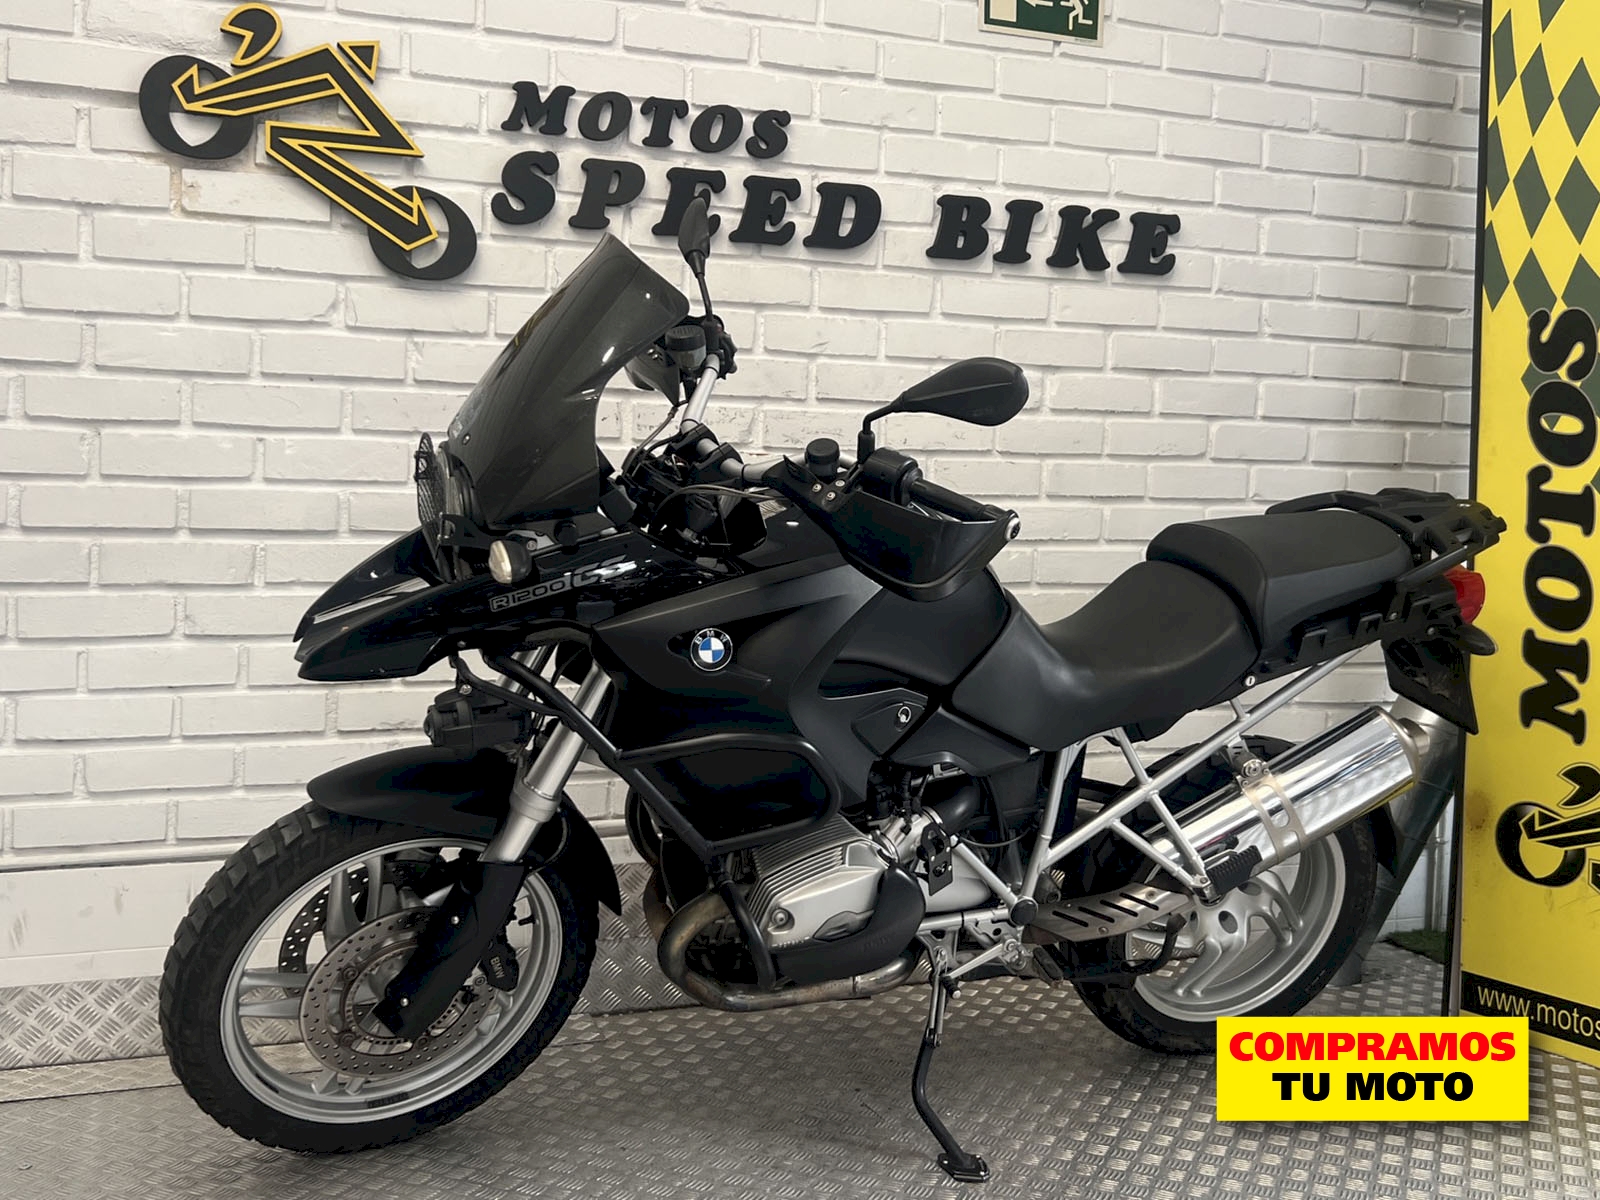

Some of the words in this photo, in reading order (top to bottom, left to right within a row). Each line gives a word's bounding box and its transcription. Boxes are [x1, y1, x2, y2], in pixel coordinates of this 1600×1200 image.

[501, 81, 791, 159] MOTOS
[491, 151, 882, 249] SPEED
[926, 194, 1181, 275] BIKE
[1519, 307, 1598, 746] MOTOS
[491, 577, 567, 611] R1200
